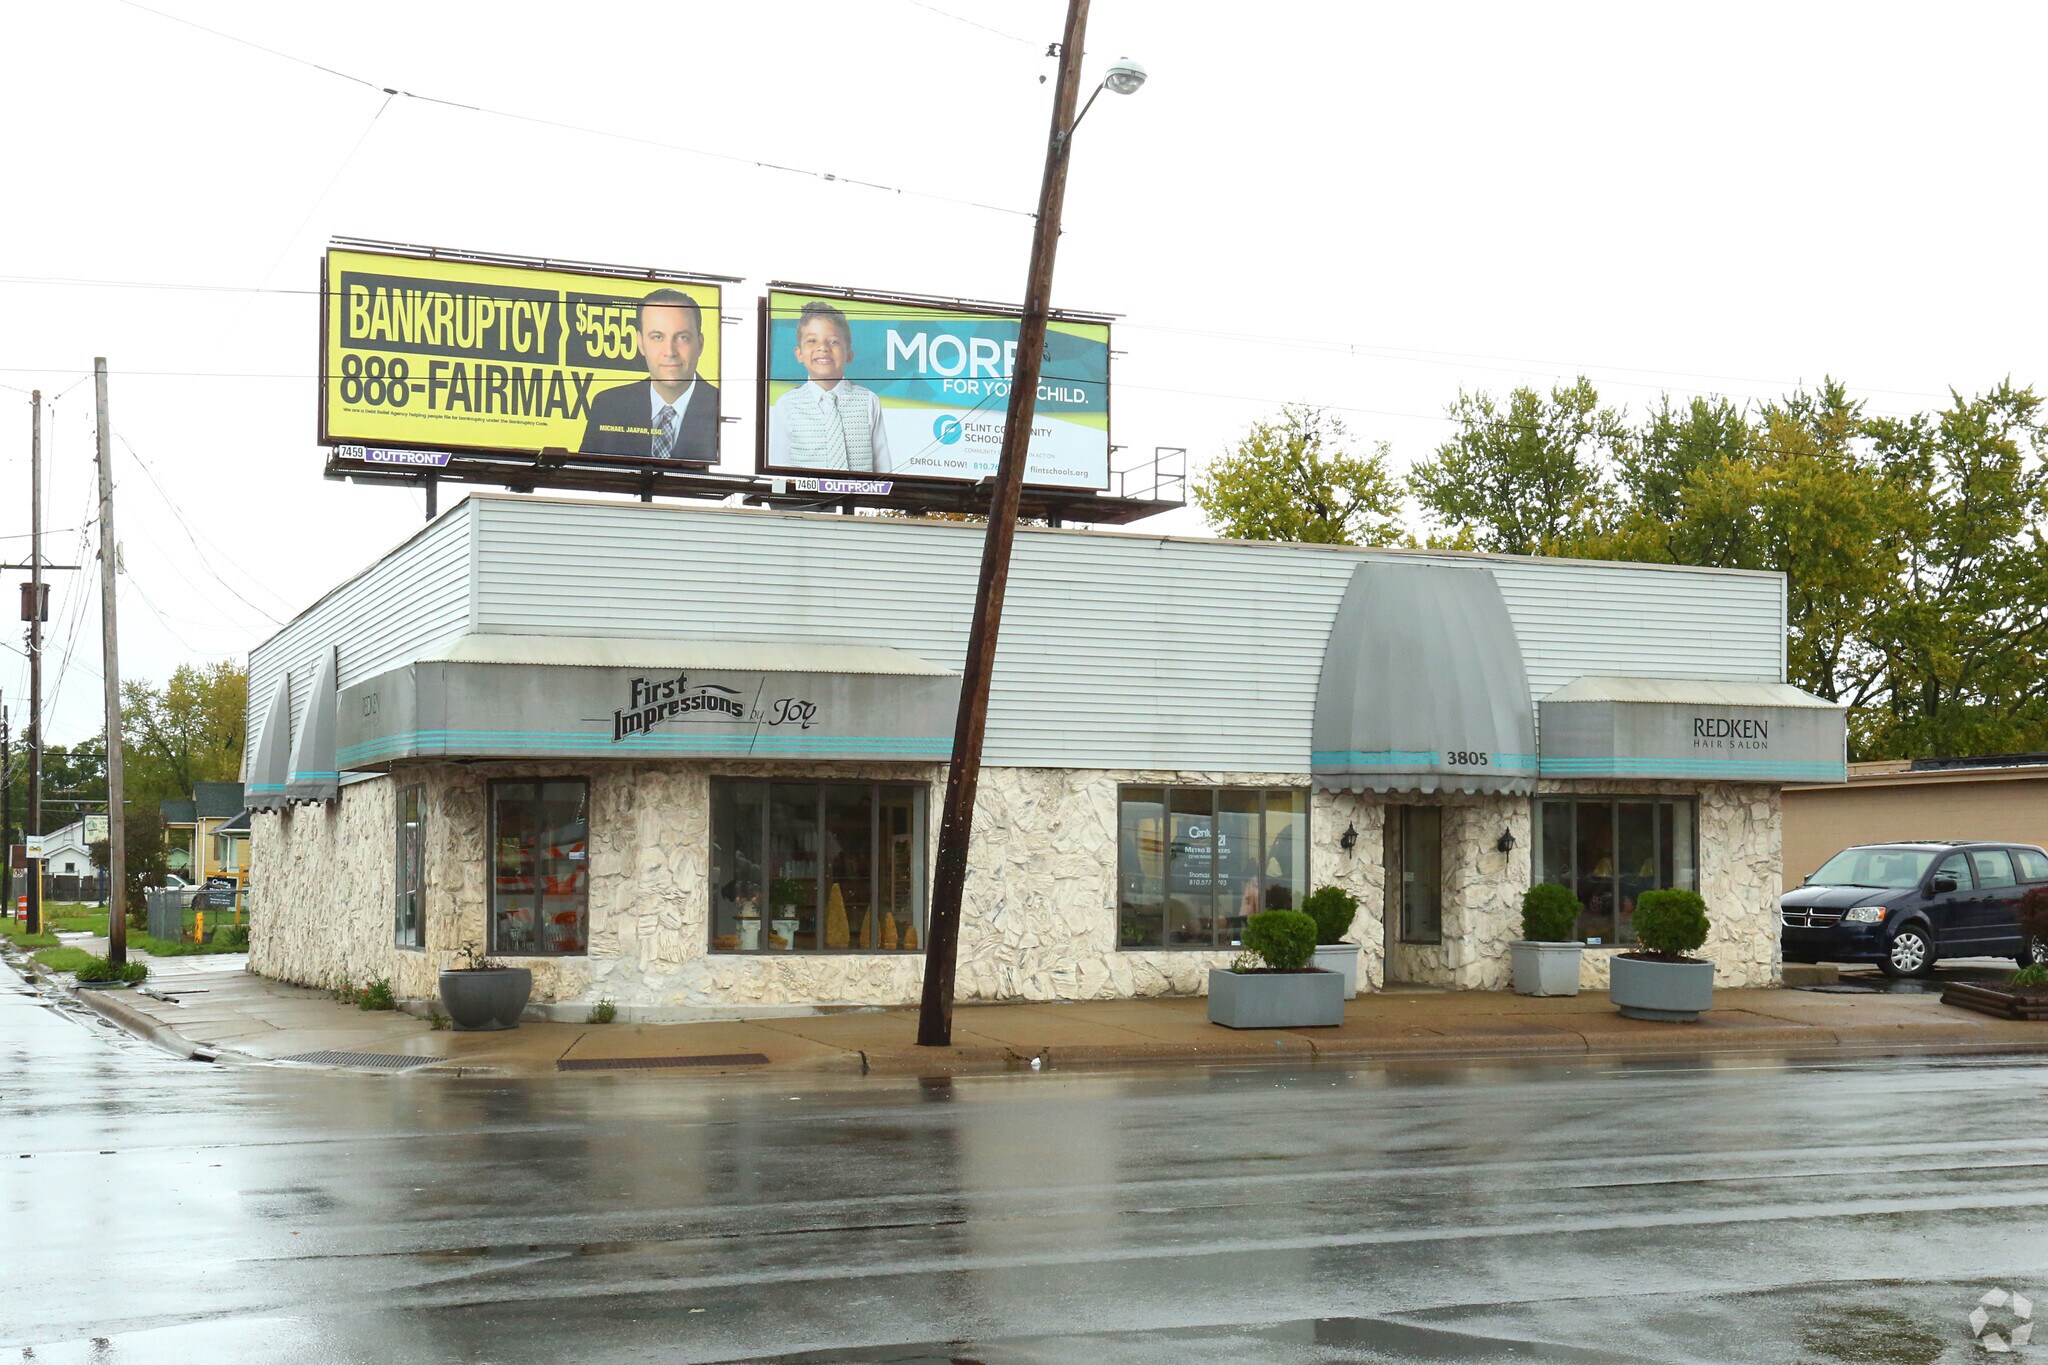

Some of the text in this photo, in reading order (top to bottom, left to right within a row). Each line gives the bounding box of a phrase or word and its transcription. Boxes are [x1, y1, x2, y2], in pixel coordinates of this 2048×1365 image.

[350, 284, 638, 360] BANKRUPTCY $555
[340, 354, 594, 420] 888-FAIRMAX
[943, 379, 979, 395] FOR
[1036, 386, 1090, 404] CHILD.
[626, 426, 649, 435] JAAFAR,
[964, 423, 1052, 437] FLINT CONITY
[964, 434, 1004, 444] SCHOOL
[341, 446, 442, 464] 7459 OUTFRONT
[910, 457, 942, 466] ENROLL
[944, 460, 968, 468] NOW!
[1030, 466, 1088, 478] flintschools.org
[798, 480, 884, 492] 7460 OUTFRONT
[630, 671, 688, 710] First
[614, 690, 743, 740] Impressions
[768, 698, 816, 730] Joy
[1694, 718, 1768, 739] REDKEN
[1694, 740, 1768, 750] HAIR SALON
[1447, 751, 1488, 766] 3805
